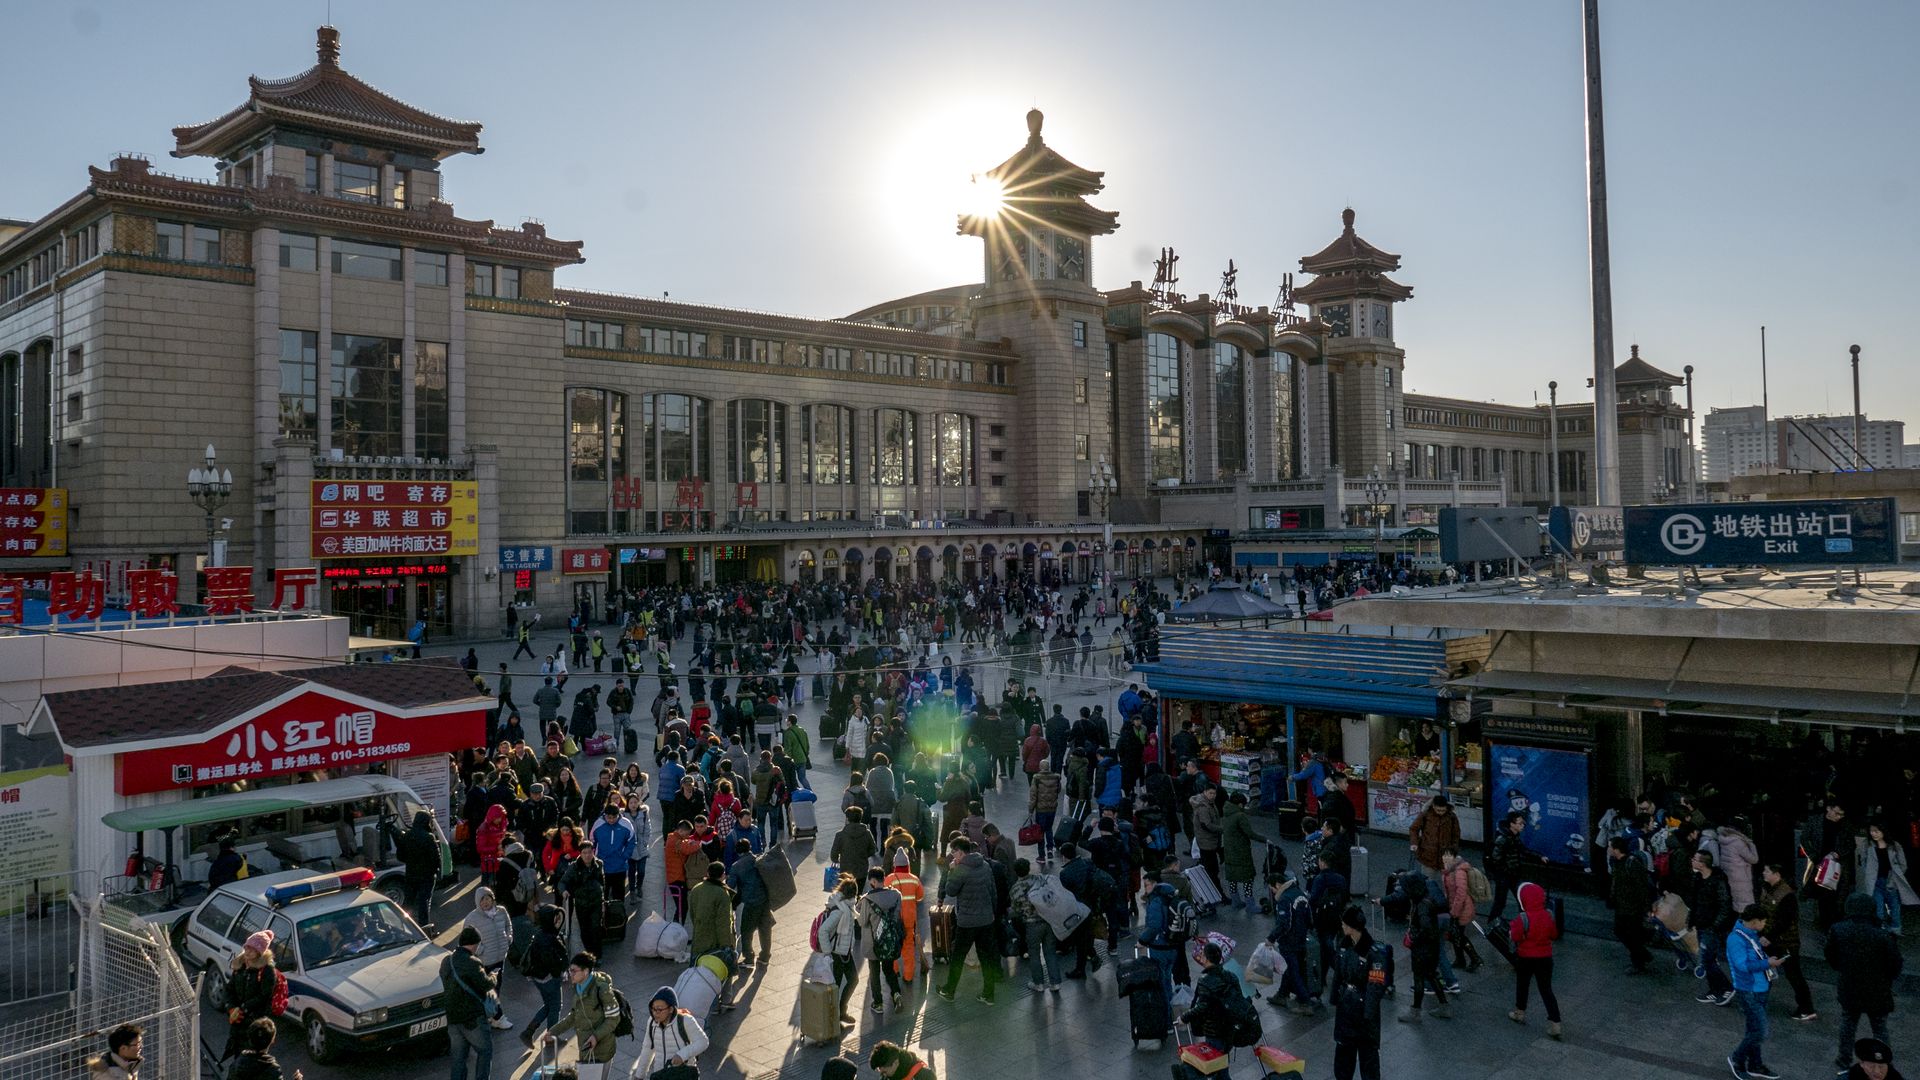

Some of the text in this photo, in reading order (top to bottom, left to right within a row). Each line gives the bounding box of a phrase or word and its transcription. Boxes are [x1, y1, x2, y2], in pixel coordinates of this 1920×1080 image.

[342, 485, 384, 502] 网吧
[407, 485, 448, 502] 寄存
[613, 474, 758, 509] 出站口
[342, 509, 448, 528] 华联超市
[664, 512, 717, 527] EXIT
[1712, 512, 1852, 538] 地铁出站口
[0, 538, 38, 551] 肉面
[342, 535, 448, 554] 美国加州牛肉面大王
[1764, 539, 1800, 554] Exit
[503, 548, 545, 562] 空售票
[572, 552, 602, 568] 超市
[226, 710, 376, 759] 小红帽
[197, 761, 264, 781] 搬运服务处
[331, 742, 411, 762] 010-51834569
